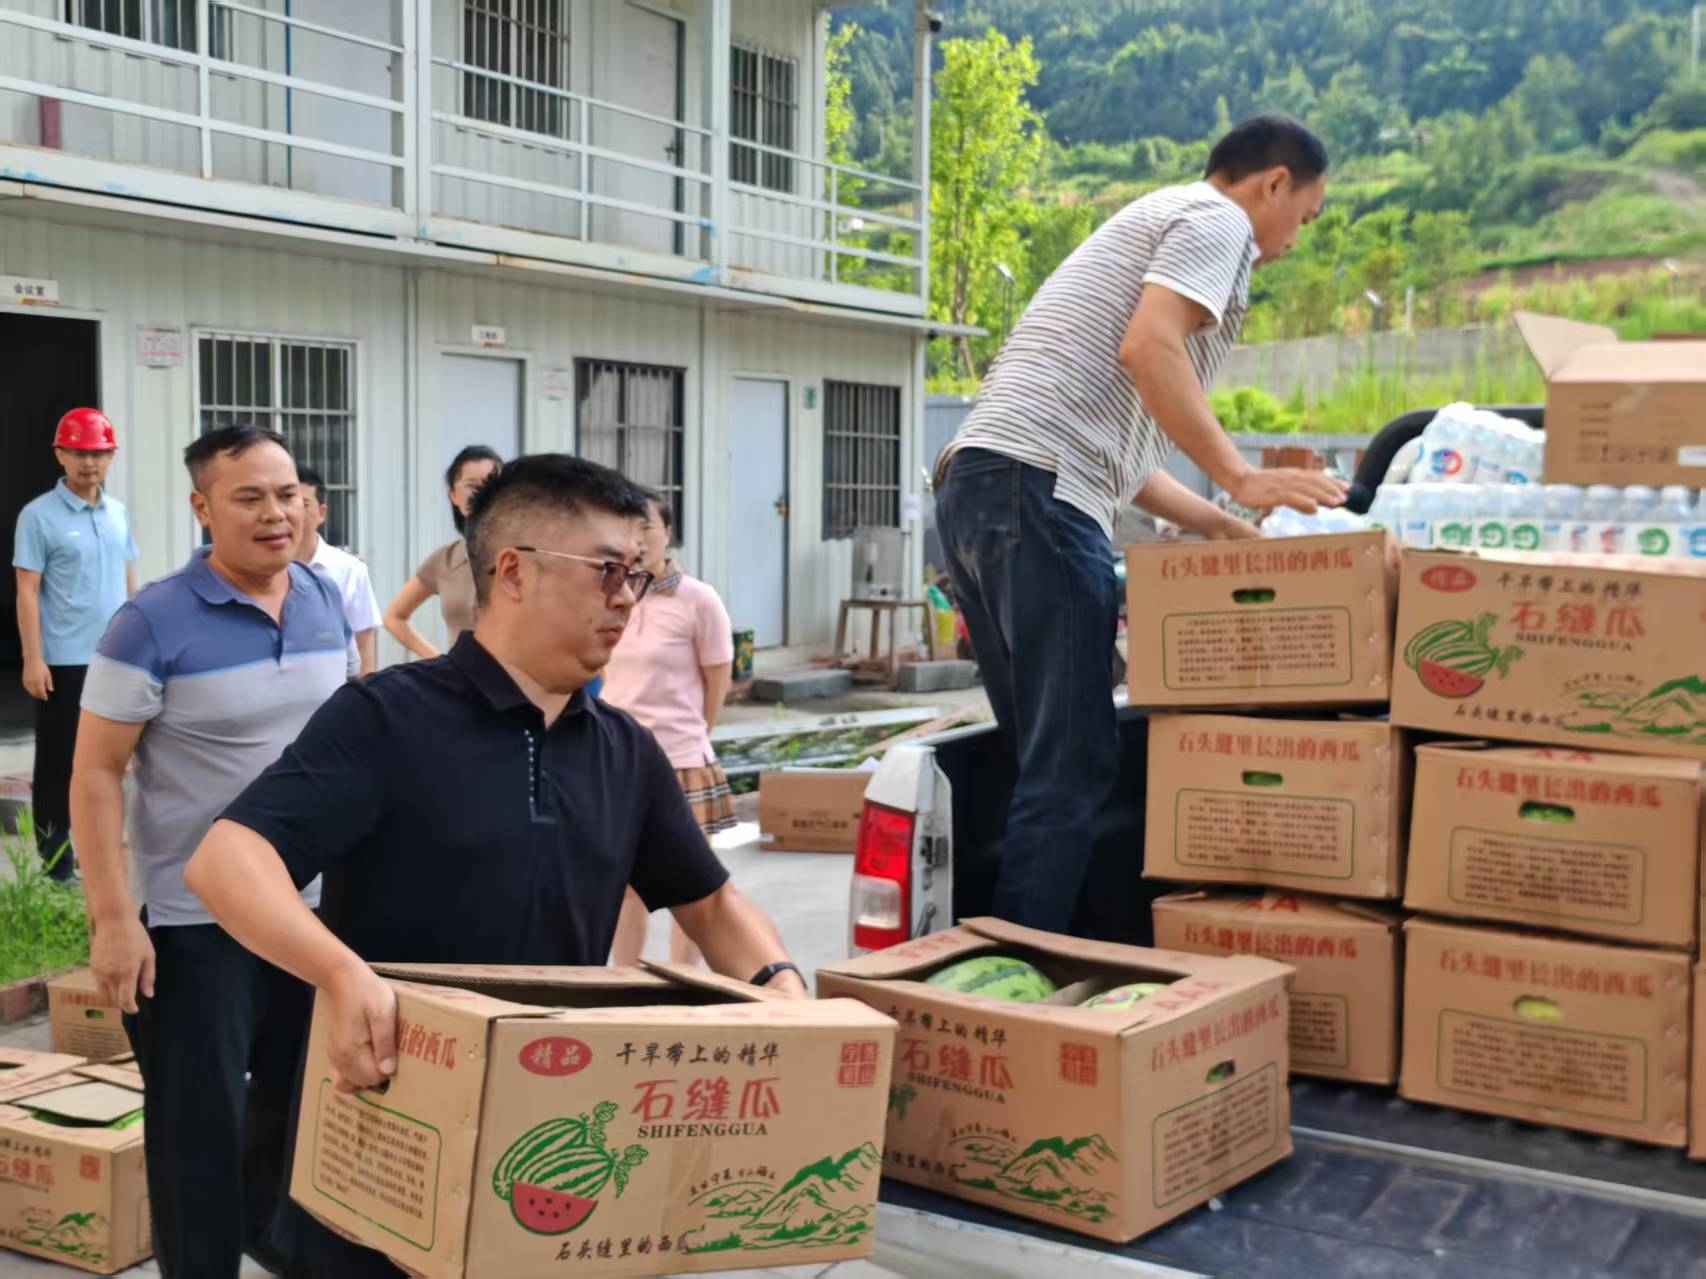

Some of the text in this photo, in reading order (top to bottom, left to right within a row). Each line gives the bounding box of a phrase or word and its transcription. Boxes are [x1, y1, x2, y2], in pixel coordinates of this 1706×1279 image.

[14, 283, 45, 296] 会议室
[1160, 547, 1353, 579] 石头缝里长出的西瓜
[1511, 601, 1647, 638] 石缝瓜
[1178, 731, 1361, 762] 石头缝里长出的西瓜
[1456, 767, 1663, 809] 石头缝里长出的西瓜
[1185, 923, 1358, 959] 石头缝里长出的西瓜
[530, 1041, 581, 1069] 精品
[616, 1041, 780, 1067] 干旱带上的精华
[903, 1038, 1015, 1090] 石缝瓜
[630, 1076, 782, 1123] 石缝瓜
[637, 1122, 768, 1138] SHIFENGGUA
